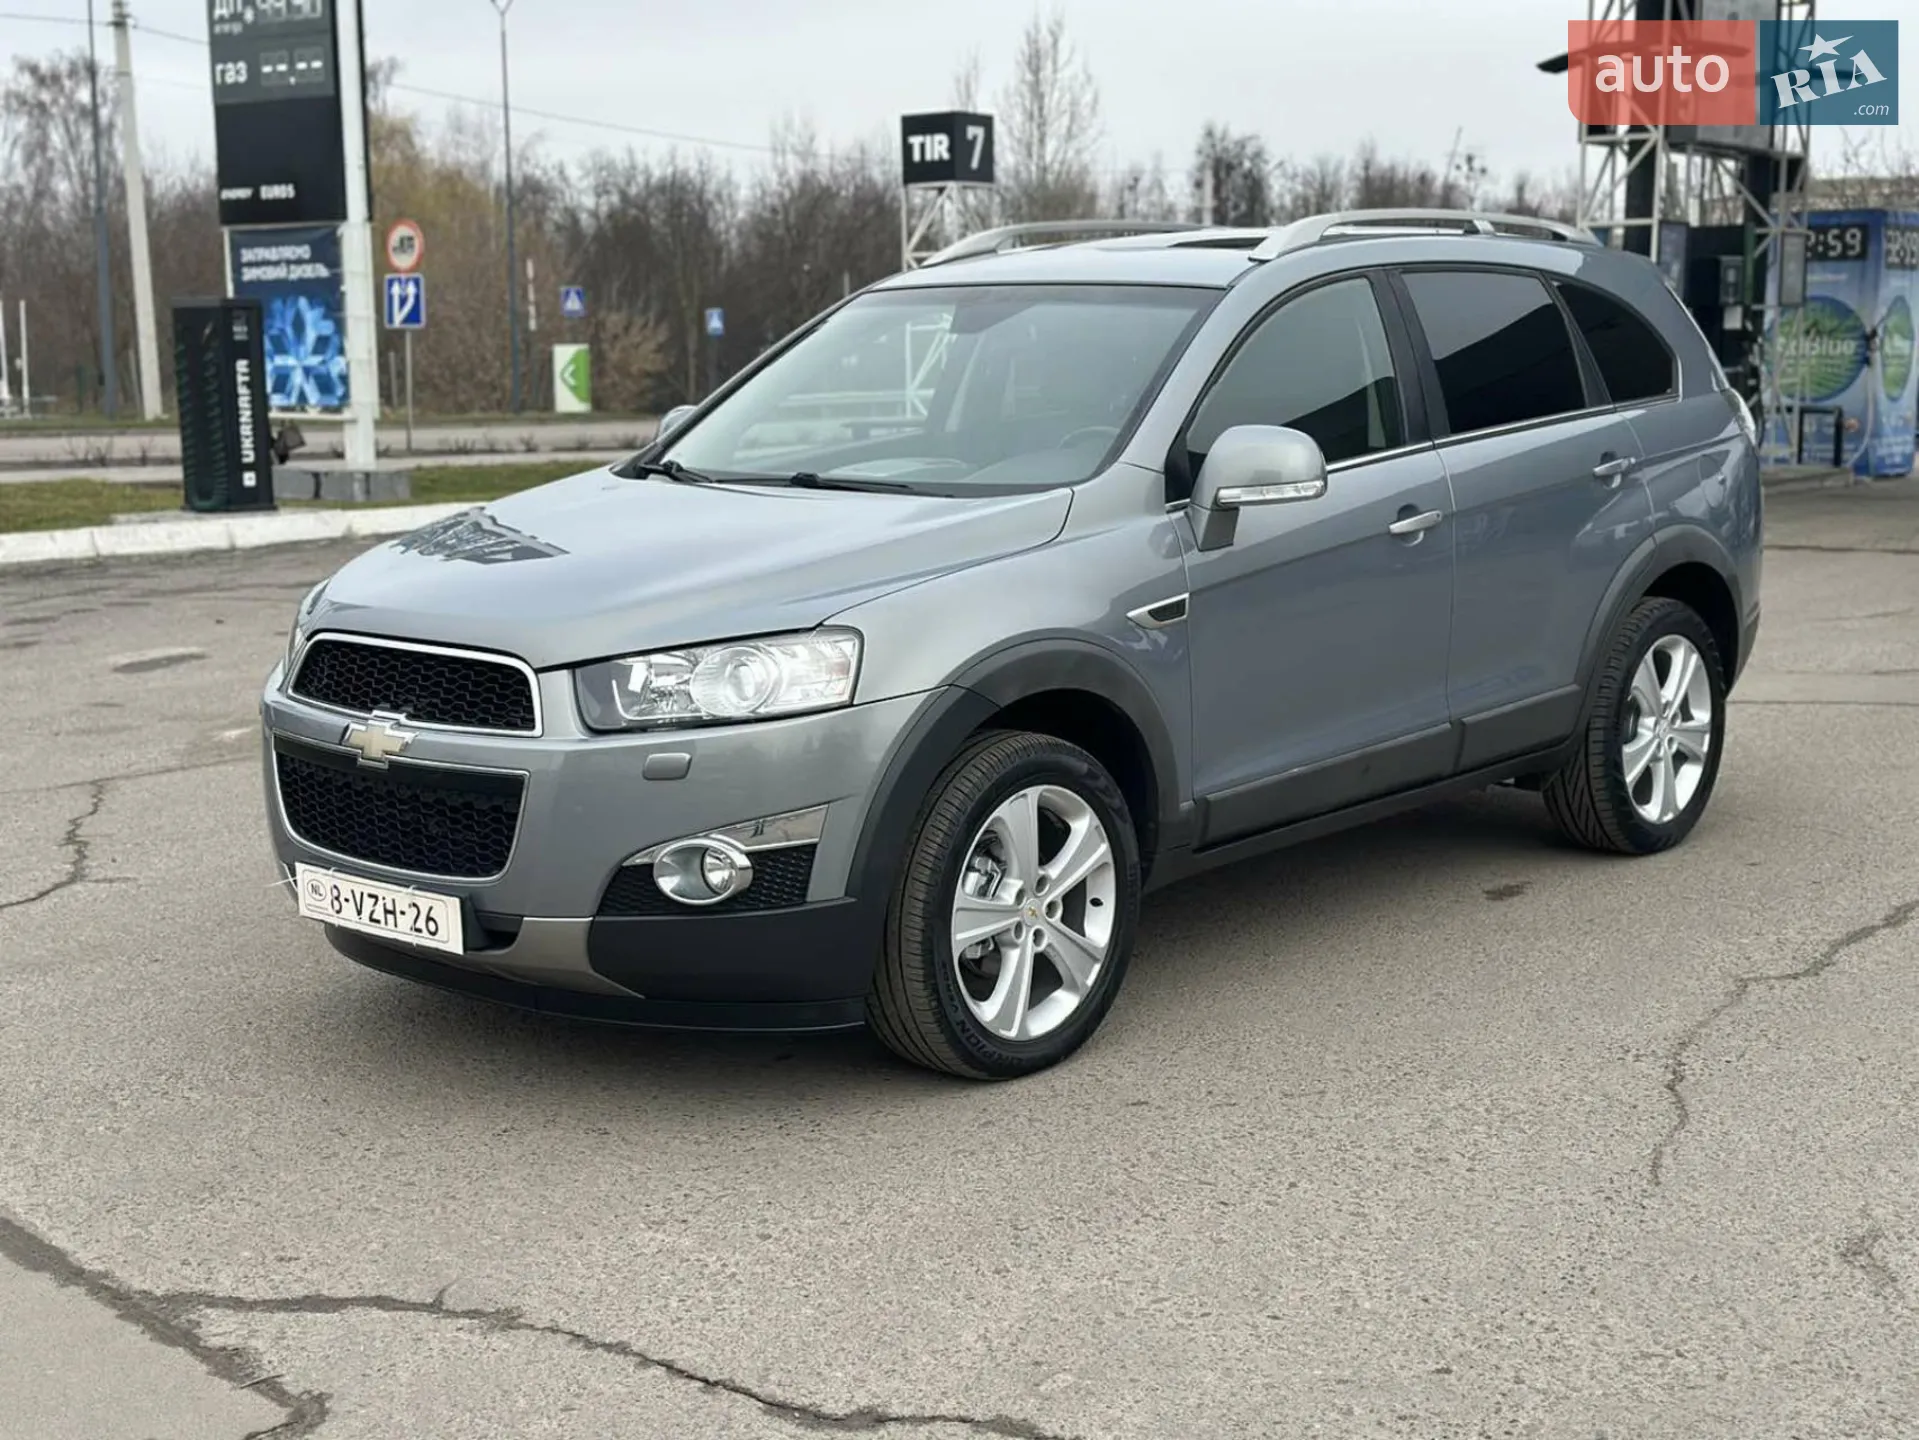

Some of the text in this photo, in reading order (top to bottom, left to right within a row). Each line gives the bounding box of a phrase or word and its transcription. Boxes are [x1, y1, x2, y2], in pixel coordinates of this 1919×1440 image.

[907, 132, 951, 163] TIR
[965, 124, 986, 171] 7
[235, 359, 255, 463] UKRNAFTA
[310, 883, 439, 937] NL 8-VZH-26
